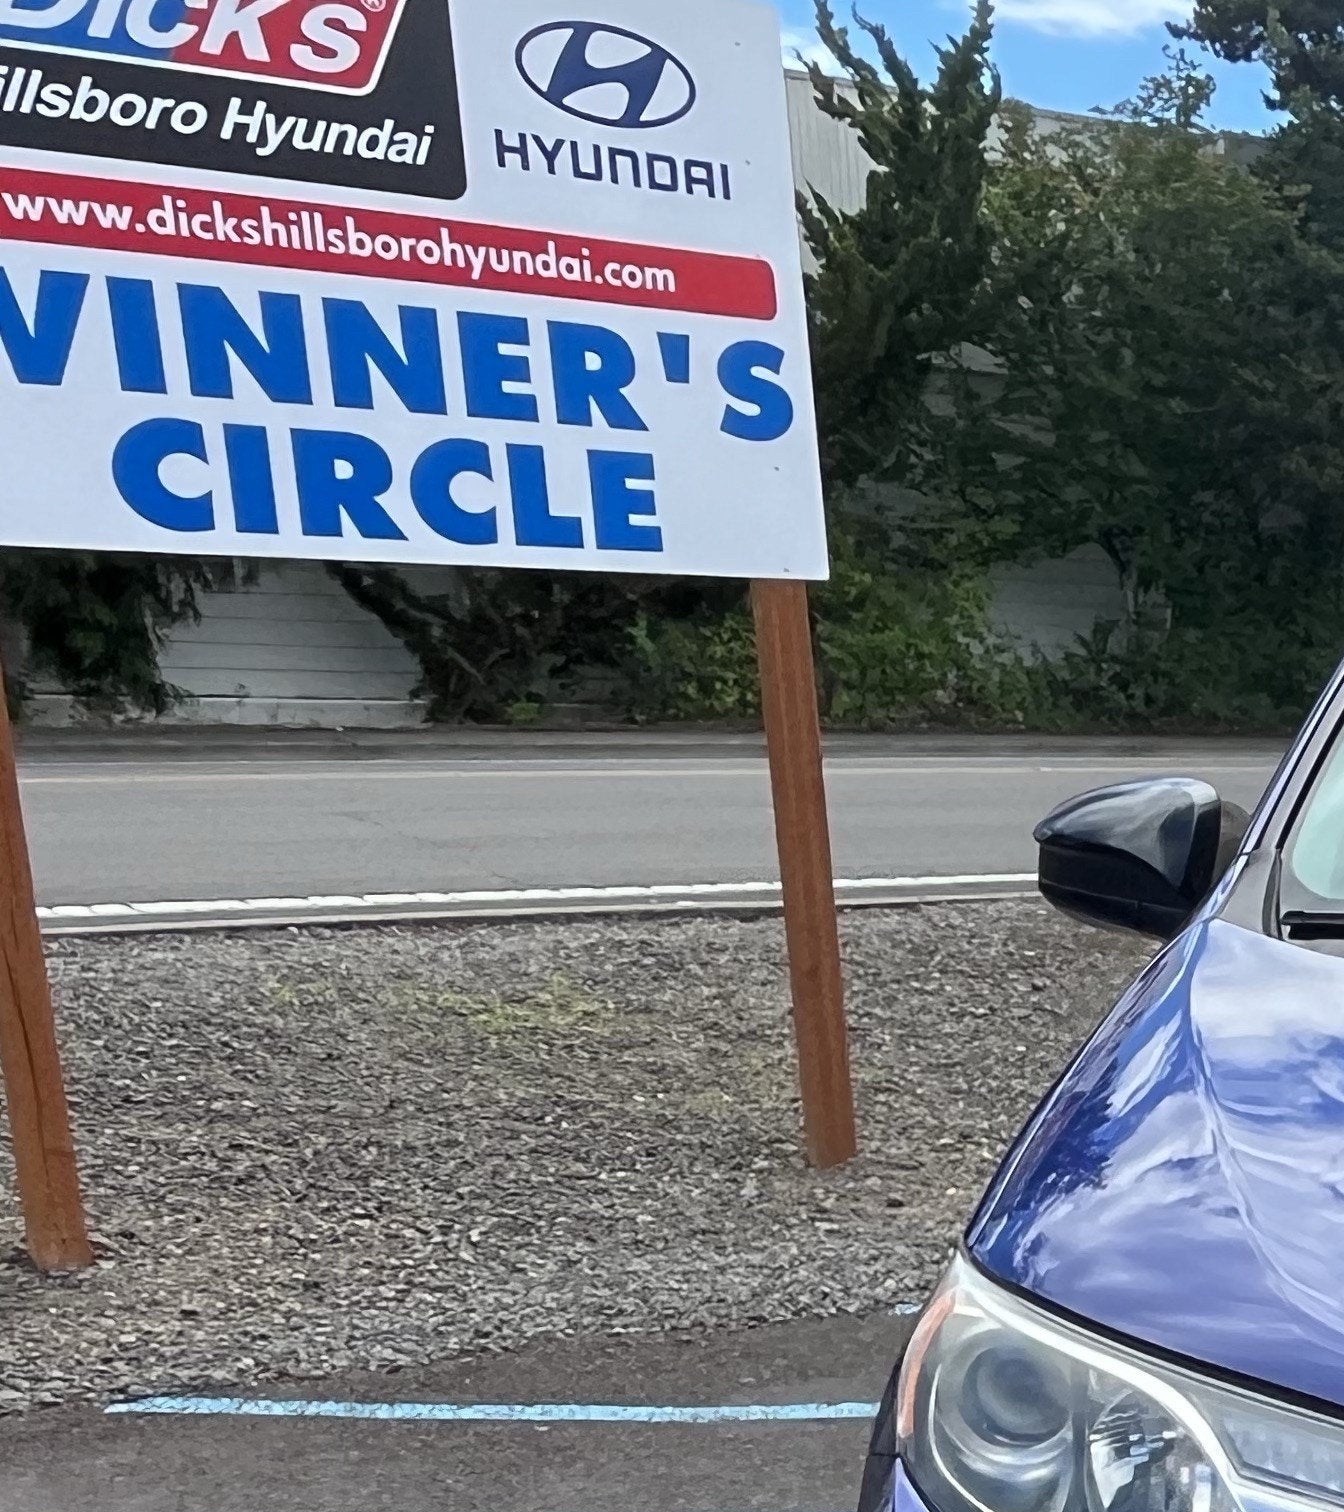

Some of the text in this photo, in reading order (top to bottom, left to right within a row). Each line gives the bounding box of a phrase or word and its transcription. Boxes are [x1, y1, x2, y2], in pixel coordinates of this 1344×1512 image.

[220, 97, 435, 166] Hyundai
[495, 128, 731, 200] HYUNDAI
[1, 194, 675, 293] www.dickshillsborohyundai.com
[112, 417, 664, 553] CIRCLE
